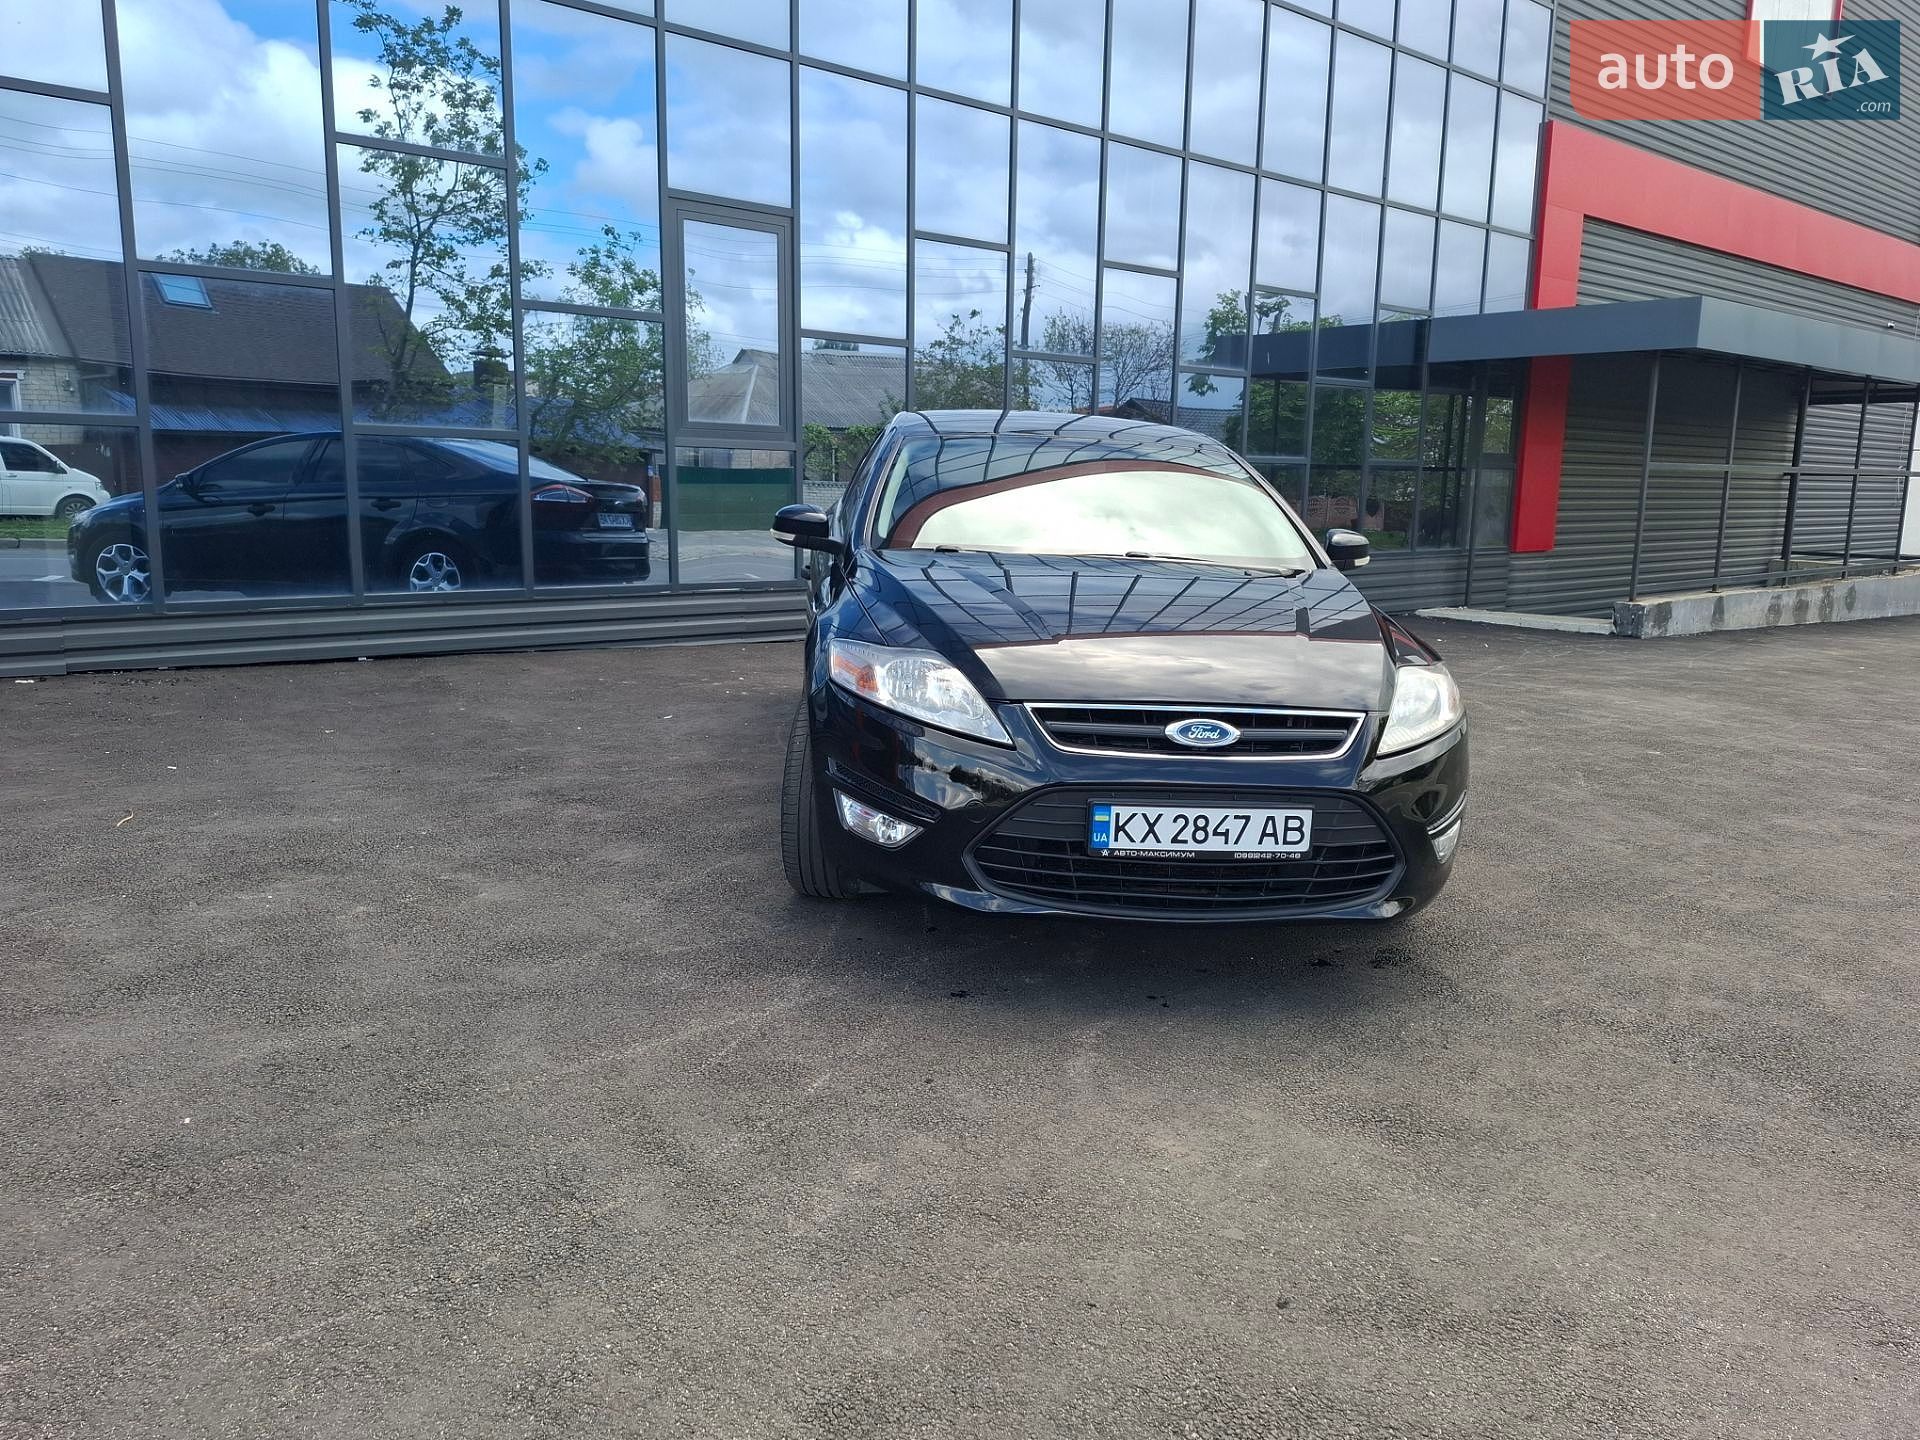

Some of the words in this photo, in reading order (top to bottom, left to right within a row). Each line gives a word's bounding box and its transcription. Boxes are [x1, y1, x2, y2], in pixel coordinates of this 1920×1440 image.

[1188, 725, 1220, 739] Ford
[1113, 812, 1164, 844] KX
[1170, 813, 1252, 845] 2847
[1257, 815, 1305, 846] AB
[1093, 832, 1108, 842] UA
